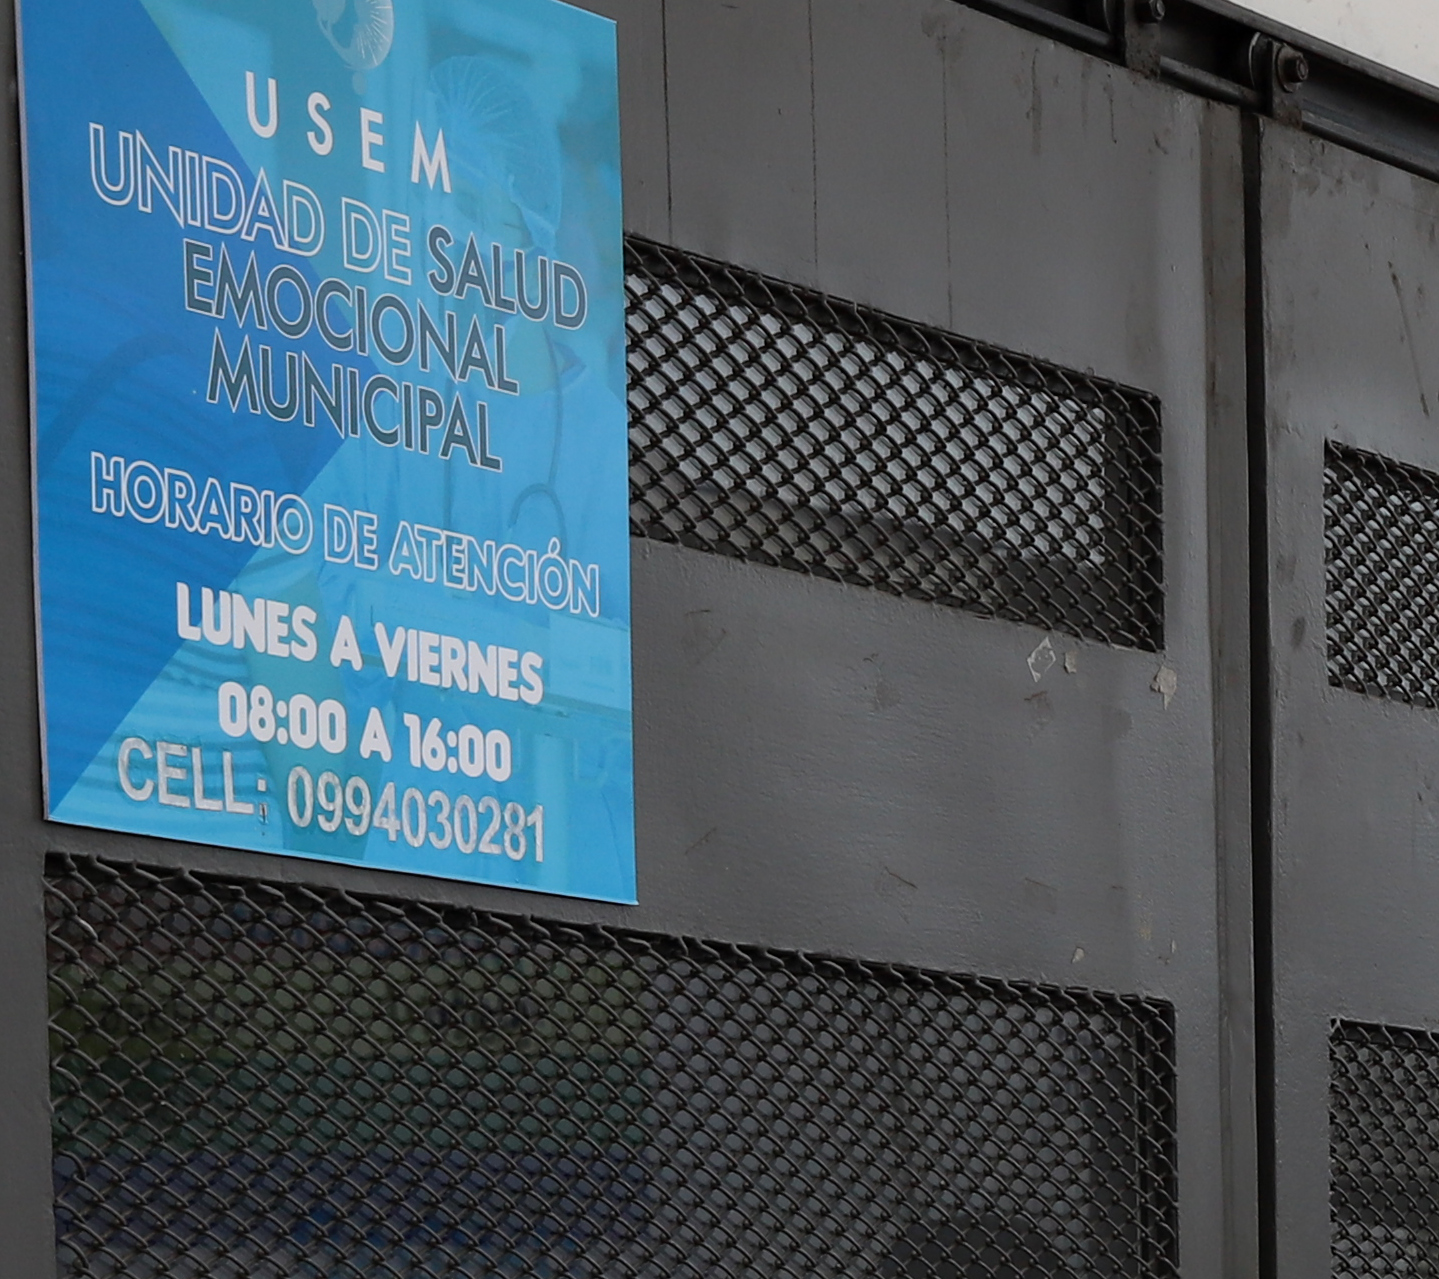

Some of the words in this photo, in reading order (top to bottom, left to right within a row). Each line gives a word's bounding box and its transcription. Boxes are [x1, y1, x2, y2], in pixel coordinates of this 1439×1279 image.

[88, 123, 325, 259] UNIDAD
[343, 196, 412, 285] DE
[427, 225, 588, 330] SALUD
[184, 239, 519, 395] EMOCIONAL
[206, 328, 502, 472] MUNICIPAL
[90, 451, 312, 555] HORARIO
[325, 505, 378, 571] DE
[390, 520, 600, 617] ATENCIÓN
[176, 582, 317, 662] LUNES
[330, 623, 363, 671] A
[375, 621, 543, 705] VIERNES
[218, 681, 346, 754] 08:00
[360, 714, 391, 764] A
[405, 714, 511, 782] 16:00
[288, 764, 545, 863] 0994030281
